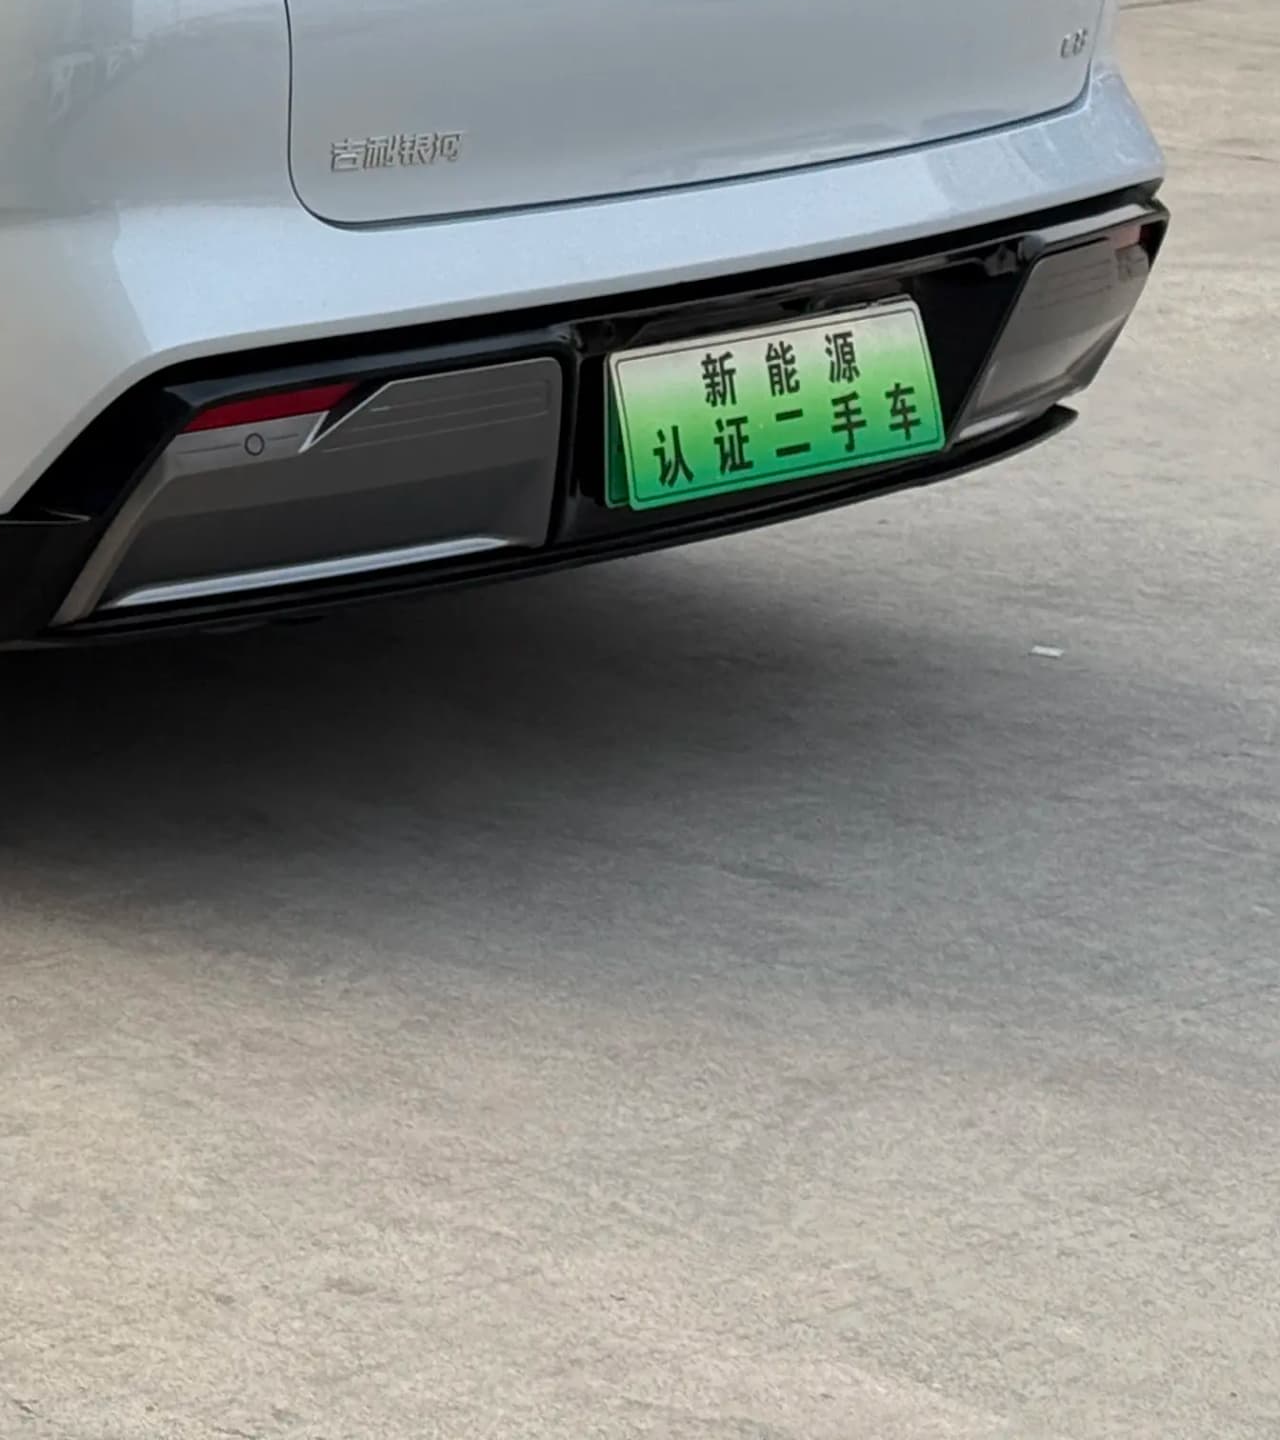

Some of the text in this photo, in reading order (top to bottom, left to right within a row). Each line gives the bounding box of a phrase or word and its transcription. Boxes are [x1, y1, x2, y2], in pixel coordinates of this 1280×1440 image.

[331, 130, 464, 172] 吉利银河
[701, 331, 860, 408] 新能源
[653, 383, 921, 487] 认证二手车
